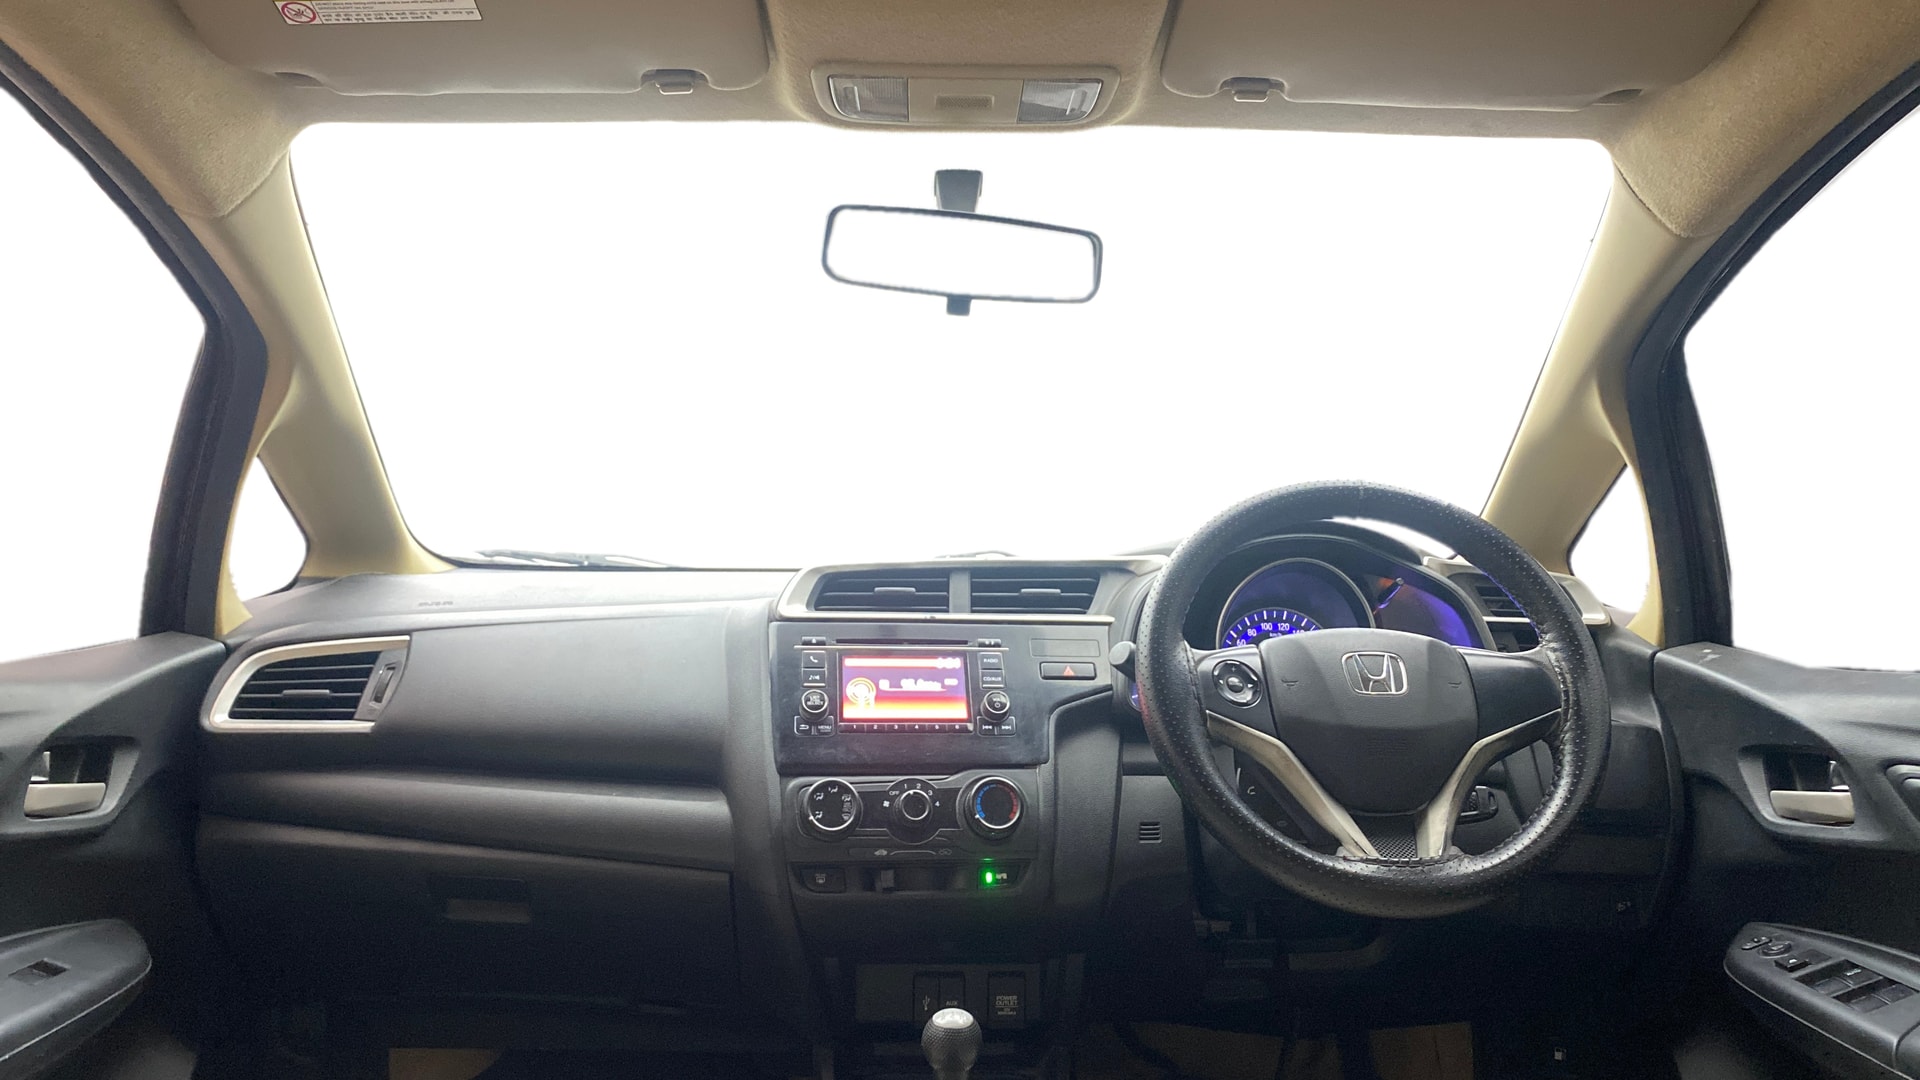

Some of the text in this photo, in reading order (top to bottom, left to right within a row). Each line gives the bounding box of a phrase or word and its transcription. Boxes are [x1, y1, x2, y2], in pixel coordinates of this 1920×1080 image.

[1260, 622, 1273, 631] 100
[1277, 622, 1290, 631] 120
[1247, 628, 1257, 637] 80
[1236, 638, 1247, 647] 60
